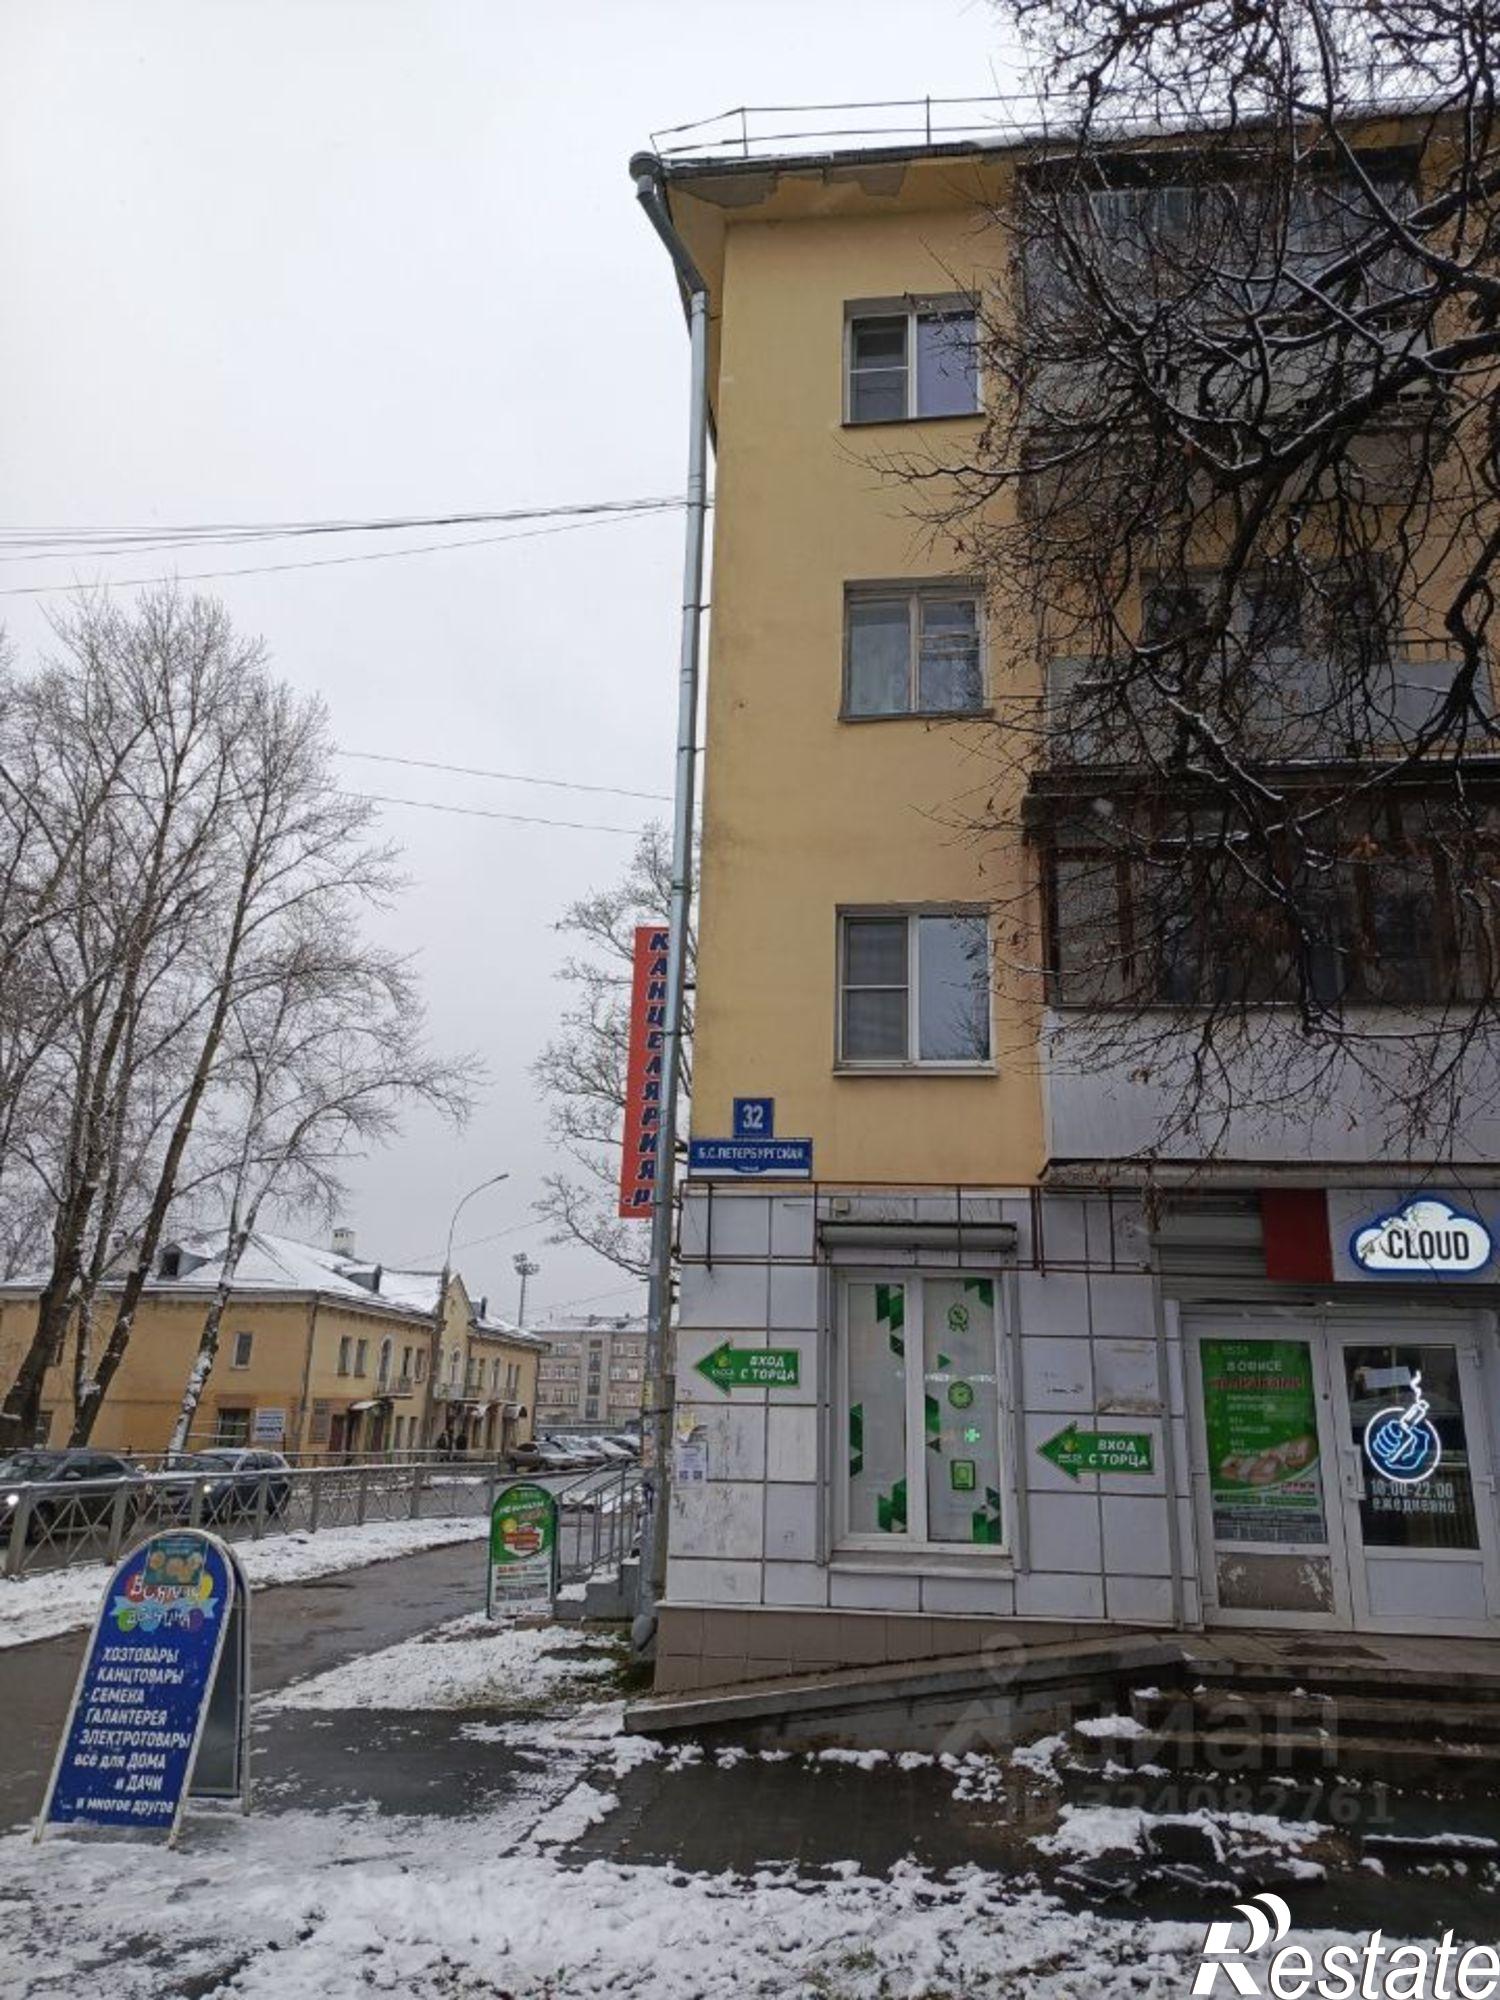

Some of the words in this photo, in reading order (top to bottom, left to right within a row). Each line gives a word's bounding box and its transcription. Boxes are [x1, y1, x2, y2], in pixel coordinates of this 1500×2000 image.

[638, 932, 669, 1179] КАНЦЕЛЯРИЯ
[742, 1104, 764, 1129] 32
[1386, 1229, 1469, 1260] CLOUD
[749, 1356, 785, 1368] ВХОД
[740, 1369, 749, 1380] С
[752, 1369, 795, 1381] ТОРЦА
[1098, 1439, 1136, 1452] ВХОД
[1088, 1453, 1098, 1465] С
[1101, 1453, 1148, 1467] ТОРЦА
[101, 1647, 180, 1664] ХОЗТОВАРЫ
[97, 1667, 184, 1685] КАНЦТОВАРЫ
[90, 1687, 145, 1703] СЕМЕНА
[84, 1707, 168, 1726] ГАЛАНТЕРЕЯ
[78, 1729, 192, 1749] ЭЛЕКТРОТОВАРЫ
[99, 1755, 126, 1769] для
[127, 1753, 166, 1771] ДОМА
[114, 1778, 125, 1790] и
[126, 1775, 164, 1792] ДАЧИ
[75, 1798, 86, 1810] и
[87, 1799, 131, 1812] многое
[131, 1801, 174, 1816] другое
